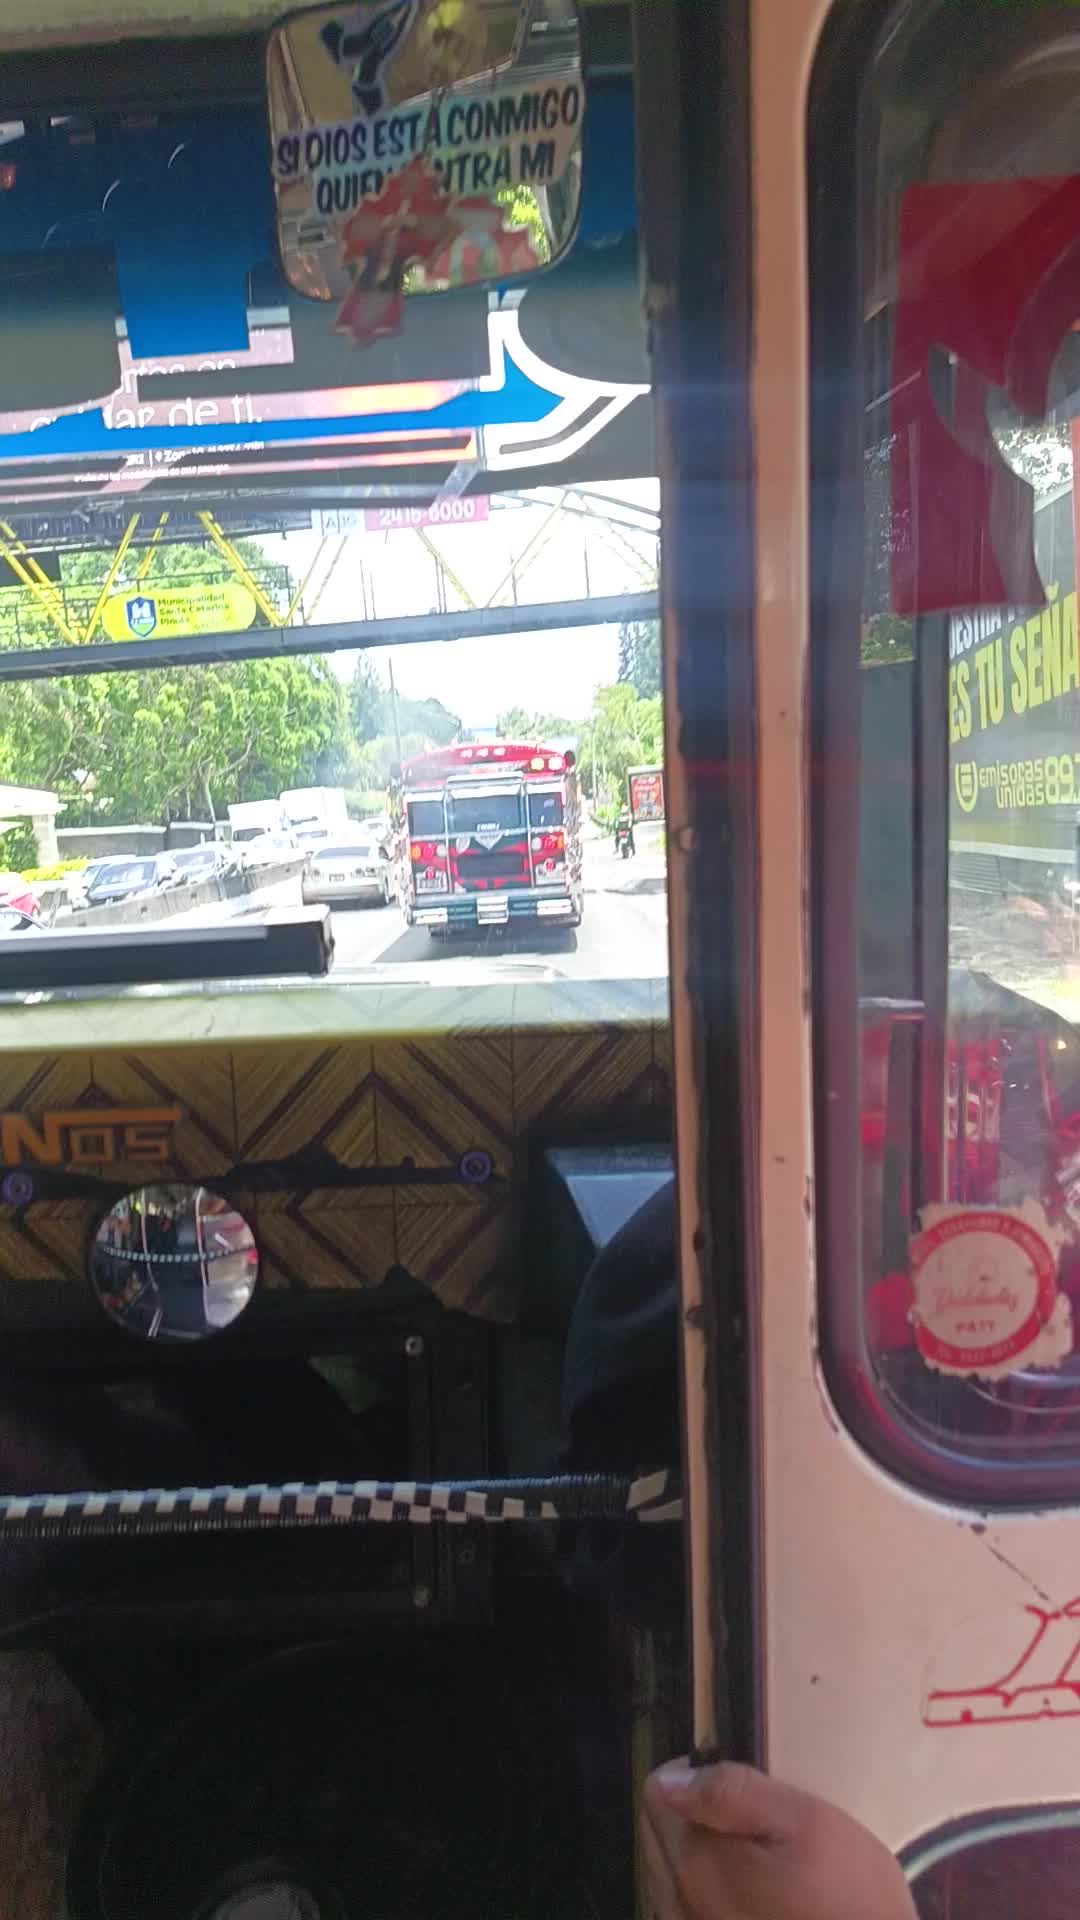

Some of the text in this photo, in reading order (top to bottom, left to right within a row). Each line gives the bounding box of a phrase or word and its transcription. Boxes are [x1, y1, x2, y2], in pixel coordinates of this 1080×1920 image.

[305, 122, 367, 170] DIOS
[447, 84, 579, 147] CONMIGO
[520, 141, 556, 180] MI
[168, 397, 219, 426] de
[158, 593, 225, 606] Municipalidad
[159, 603, 230, 615] Santa Catarina
[160, 616, 190, 625] Pinula
[949, 660, 972, 744] ES
[975, 638, 1004, 730] TU
[979, 758, 1044, 788] emisoras
[996, 783, 1045, 809] unidas
